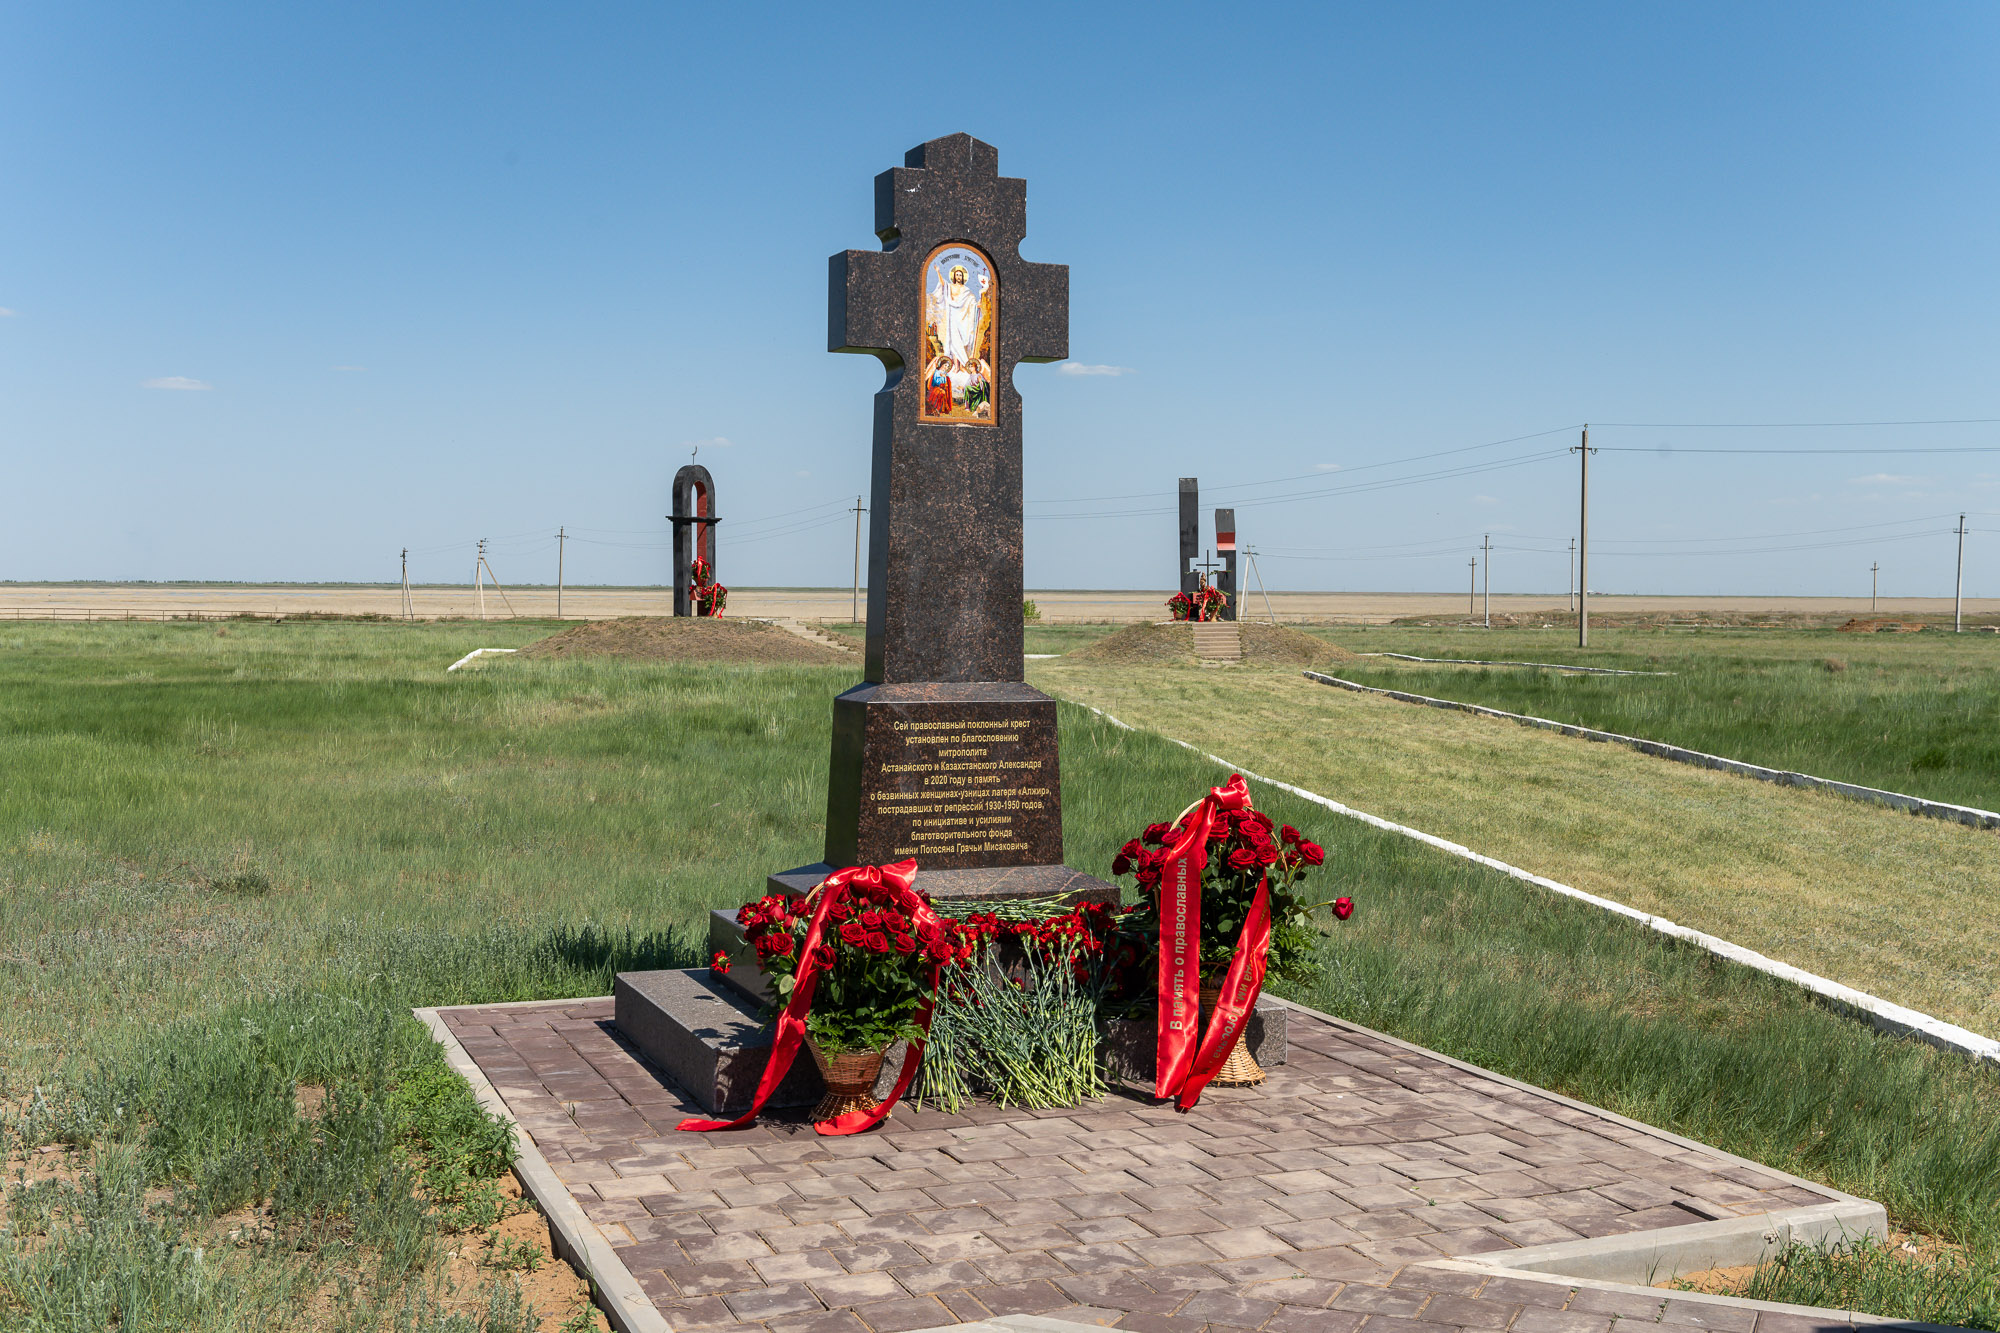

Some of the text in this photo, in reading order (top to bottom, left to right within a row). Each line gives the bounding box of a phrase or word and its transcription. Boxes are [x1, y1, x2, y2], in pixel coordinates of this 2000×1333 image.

[894, 719, 1030, 732] Сей православный поклонный крест
[906, 734, 1018, 745] установлен по благословению
[939, 749, 987, 760] митрополита
[882, 762, 932, 773] Астанайского
[941, 762, 997, 771] Казахстанского
[999, 760, 1042, 770] Александра
[931, 776, 947, 784] 2020
[950, 776, 966, 786] году
[877, 791, 919, 800] безвинных
[921, 790, 989, 800] женщинах-узницах
[992, 788, 1016, 797] лагеря
[878, 804, 932, 814] пострадавших
[944, 801, 983, 813] репрессий
[986, 801, 1019, 810] 1930-1950
[1022, 801, 1044, 810] годов,
[924, 817, 967, 827] инициативе
[976, 816, 1011, 825] усилиями
[911, 830, 1012, 842] благотворительного фонда
[895, 841, 1028, 855] имени Погосяна Грачьи Мисаковича
[1170, 857, 1188, 1030] В память о православных
[1235, 983, 1249, 1003] им.
